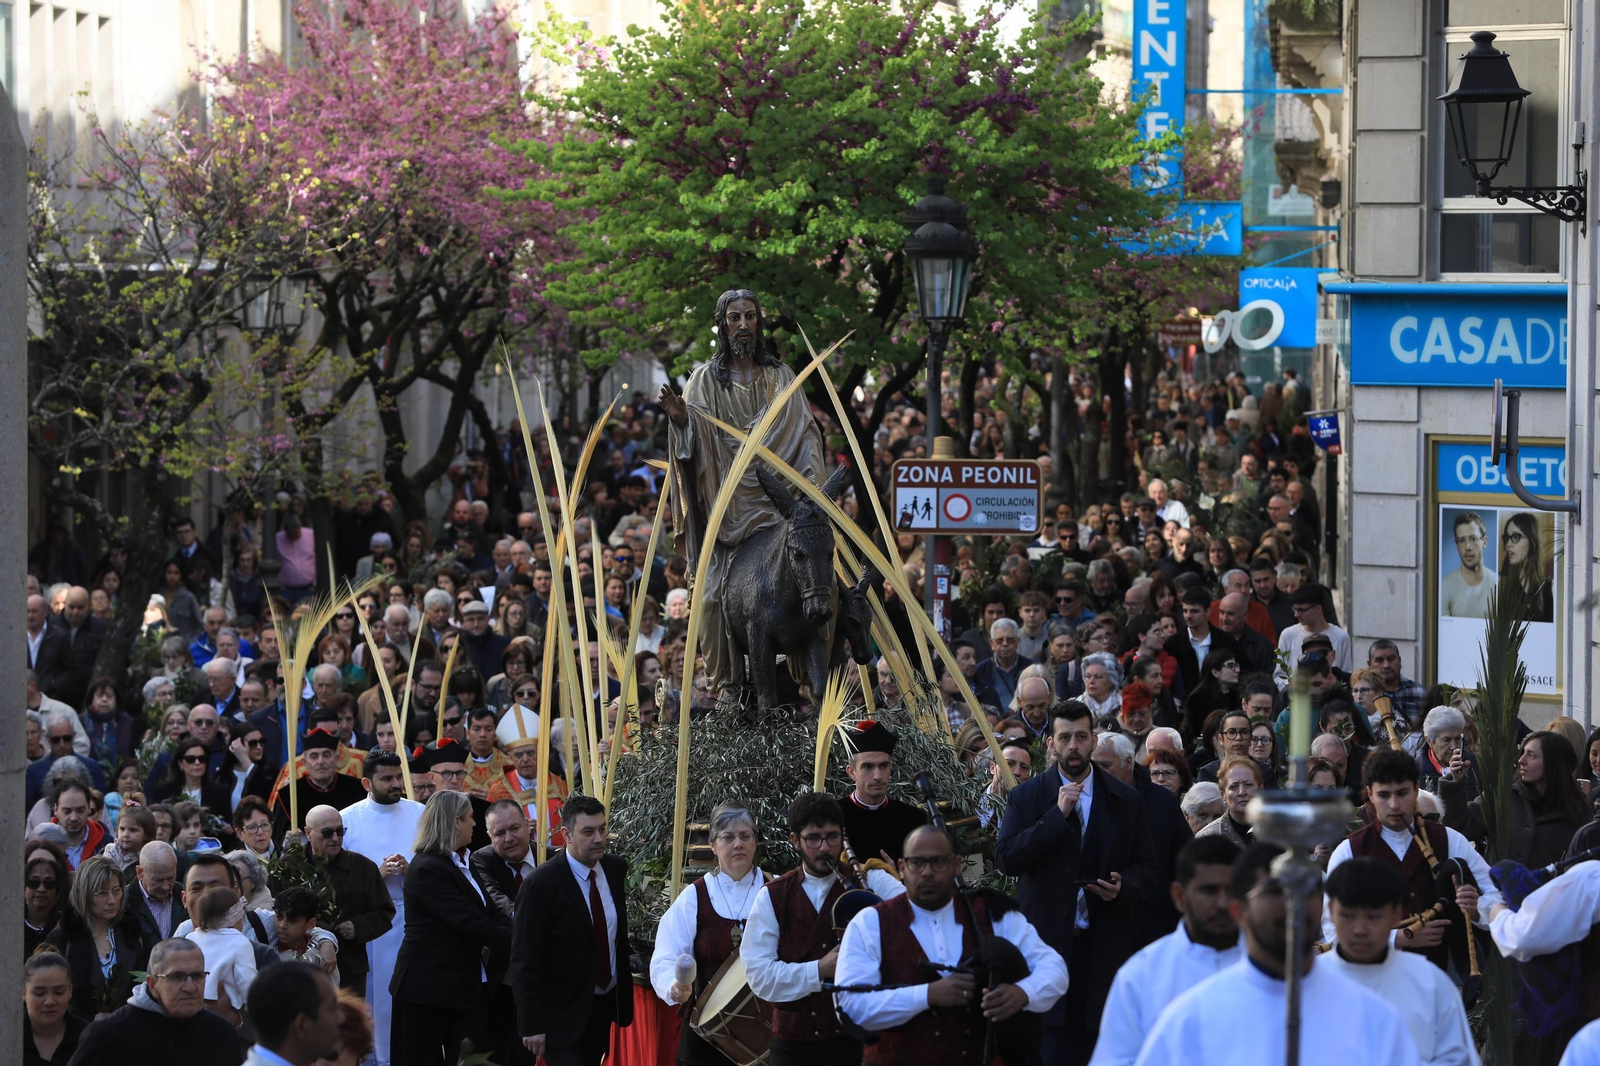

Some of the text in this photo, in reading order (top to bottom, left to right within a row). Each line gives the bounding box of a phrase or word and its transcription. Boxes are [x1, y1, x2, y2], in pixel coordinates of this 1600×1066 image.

[897, 466, 1037, 484] ZONA PEONIL
[975, 494, 1035, 507] CIRCULACIÓN
[1525, 674, 1554, 686] RSACE
